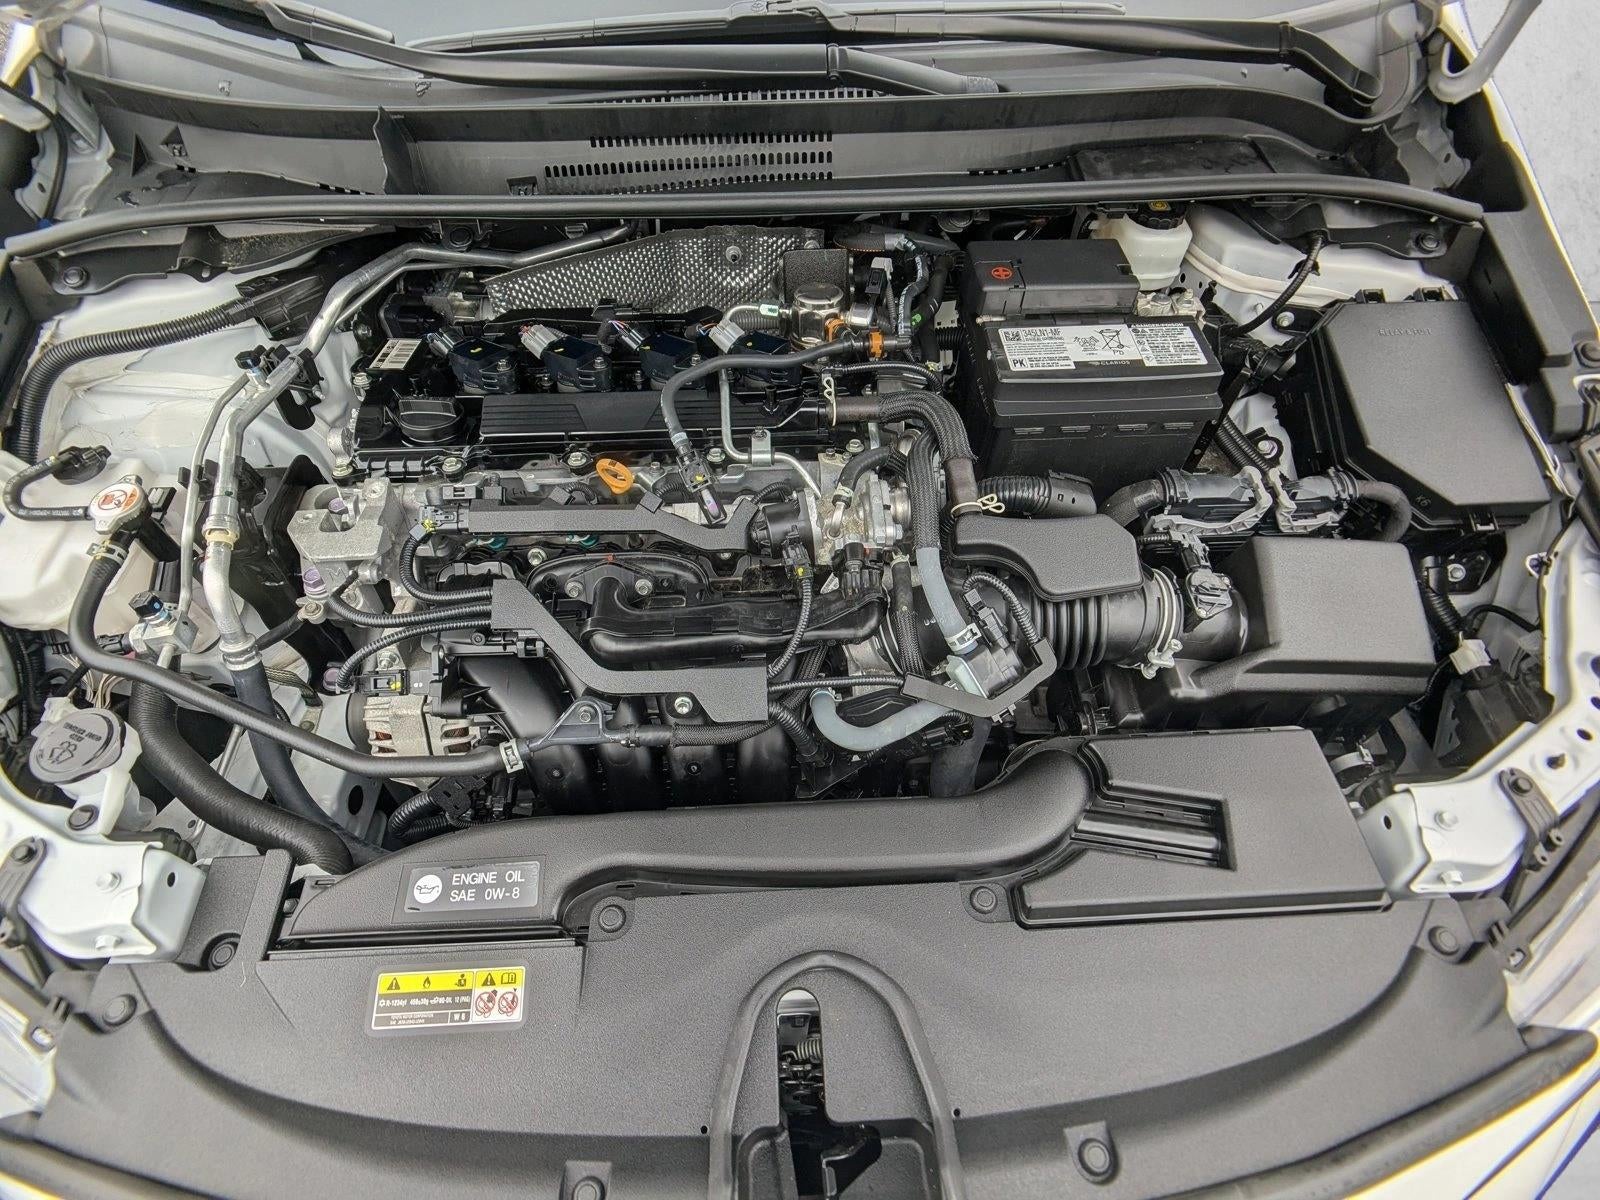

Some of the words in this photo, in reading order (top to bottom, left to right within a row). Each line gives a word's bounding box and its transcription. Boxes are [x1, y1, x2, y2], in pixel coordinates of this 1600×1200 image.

[1012, 359, 1026, 368] PK
[452, 871, 497, 886] ENGINE
[505, 870, 525, 883] OIL
[450, 889, 476, 902] SAE
[484, 887, 520, 900] 0W-8
